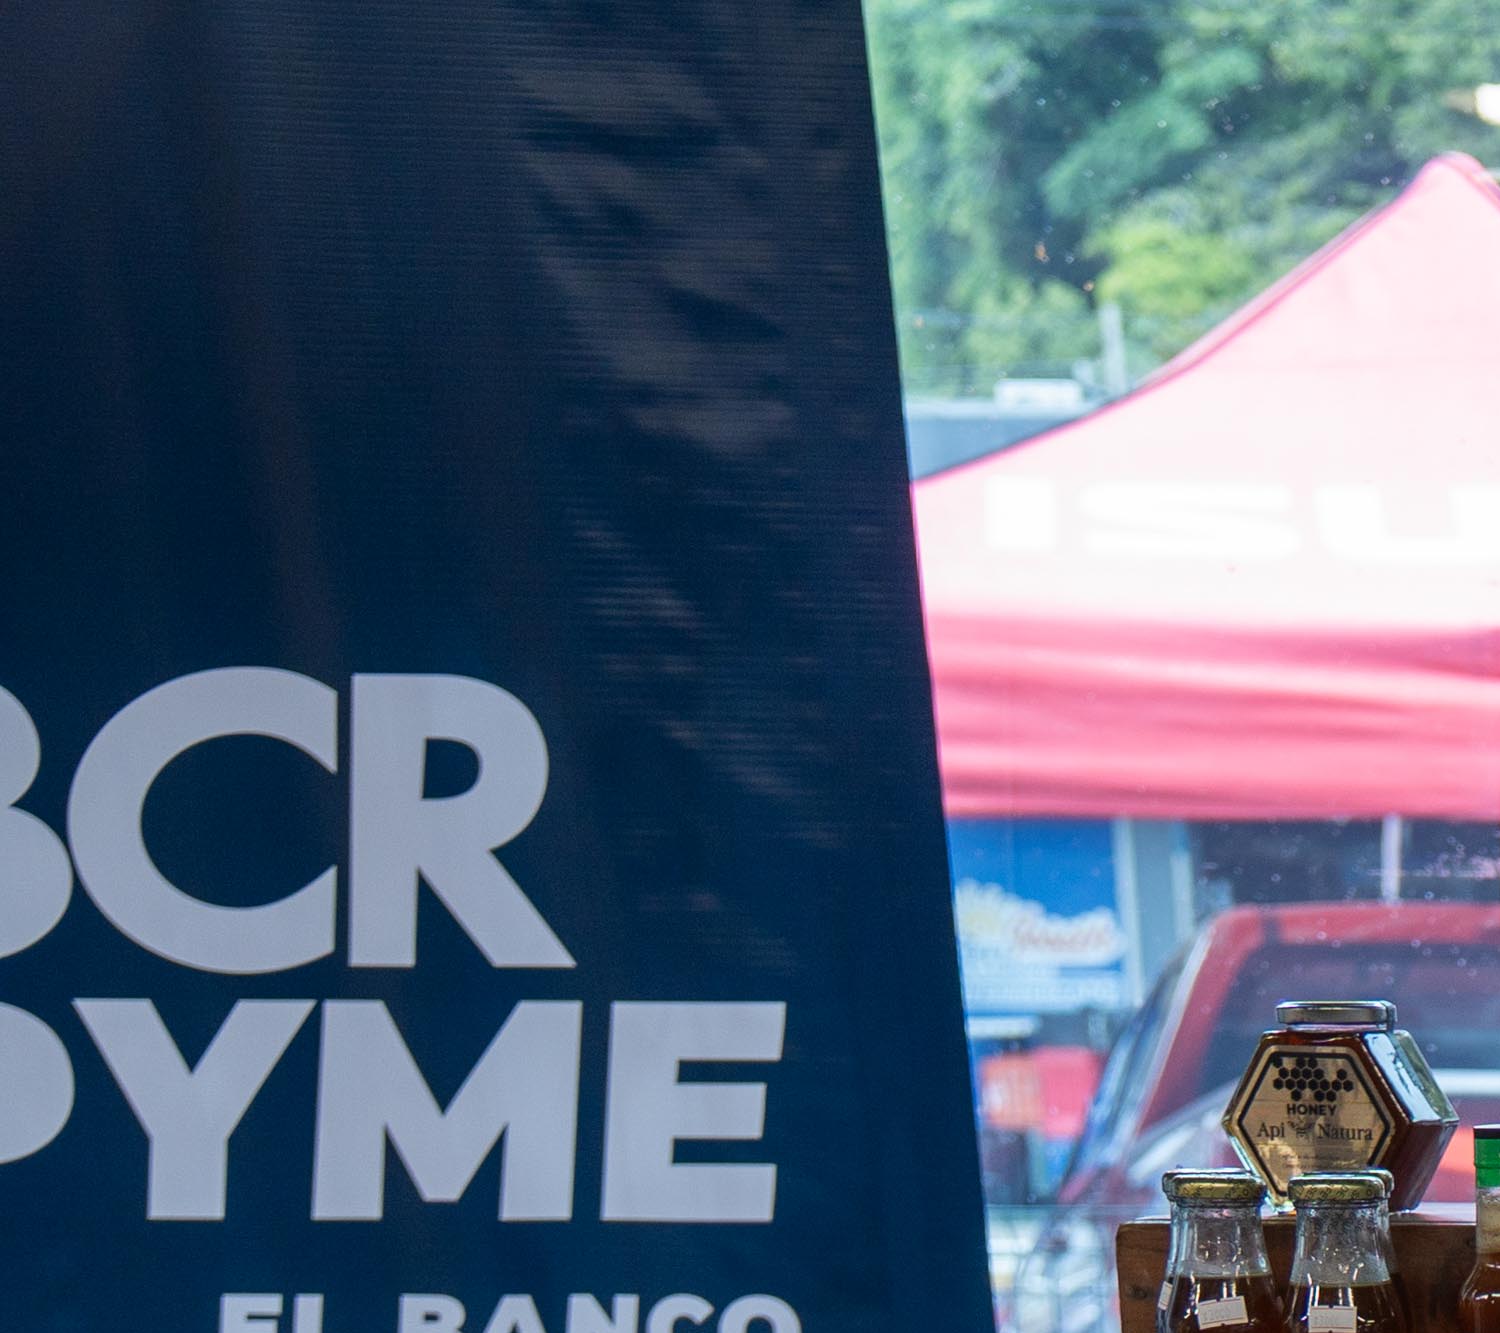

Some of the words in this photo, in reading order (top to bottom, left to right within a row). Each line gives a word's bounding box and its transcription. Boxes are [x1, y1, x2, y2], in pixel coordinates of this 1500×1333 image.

[1287, 1104, 1337, 1115] HONEY
[1257, 1122, 1285, 1140] Api
[1316, 1123, 1373, 1140] Natura
